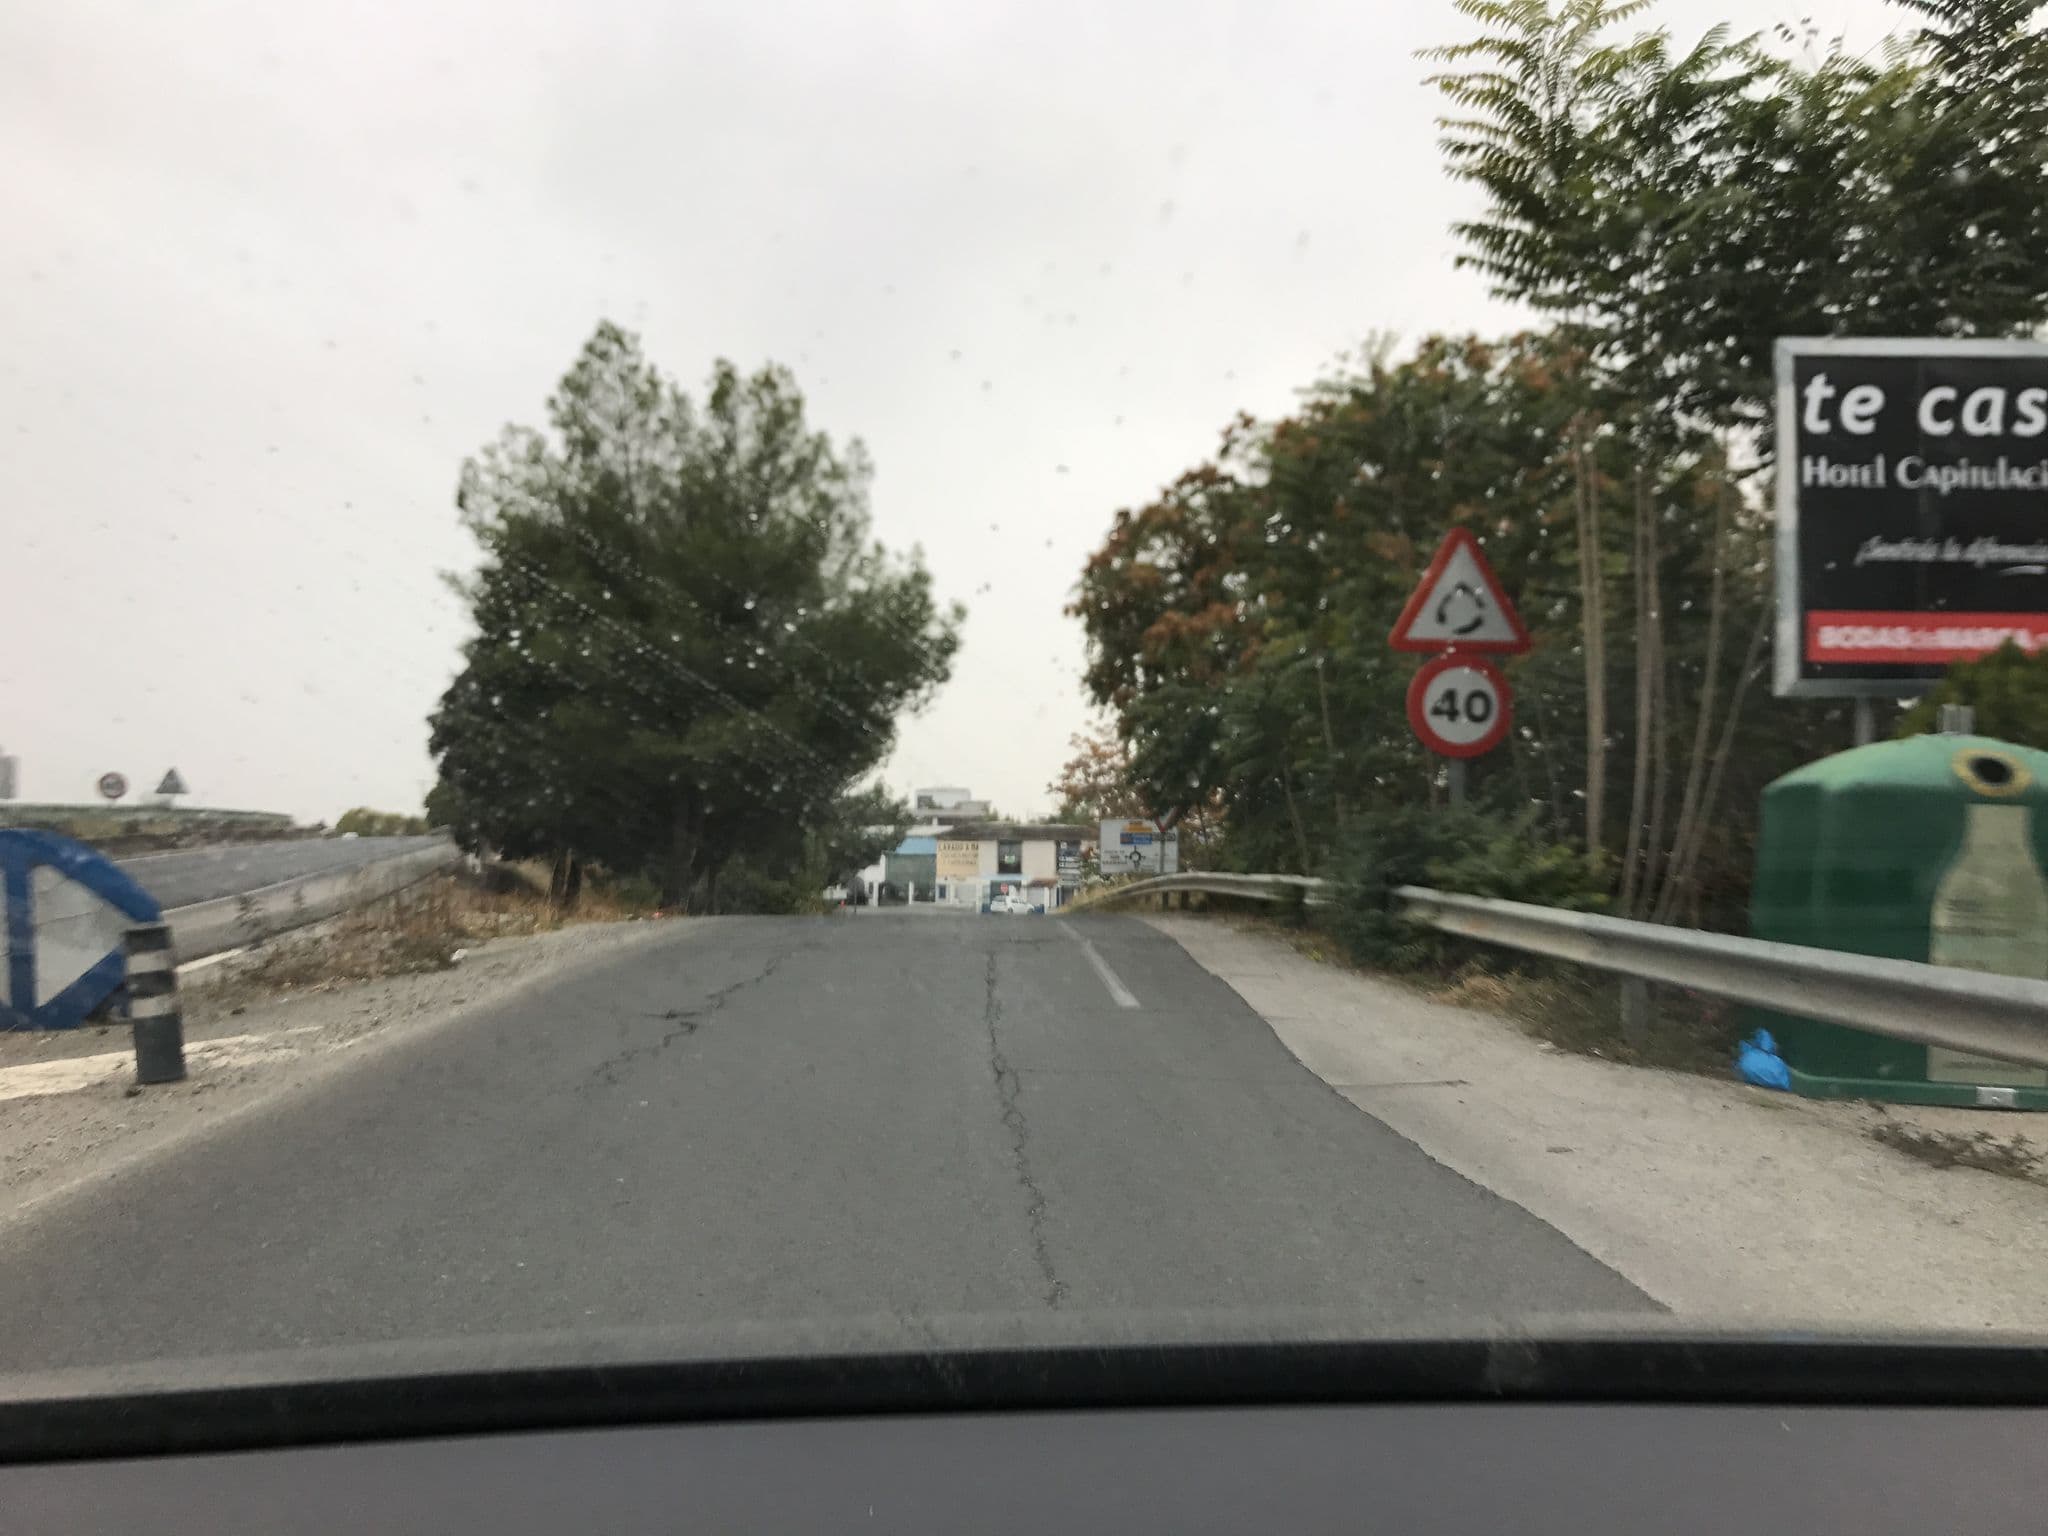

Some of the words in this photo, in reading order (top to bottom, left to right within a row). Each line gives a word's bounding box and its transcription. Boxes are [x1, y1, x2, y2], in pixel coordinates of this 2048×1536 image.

[1803, 373, 1885, 435] te
[1802, 453, 1886, 489] Hotel
[1430, 688, 1492, 724] 40
